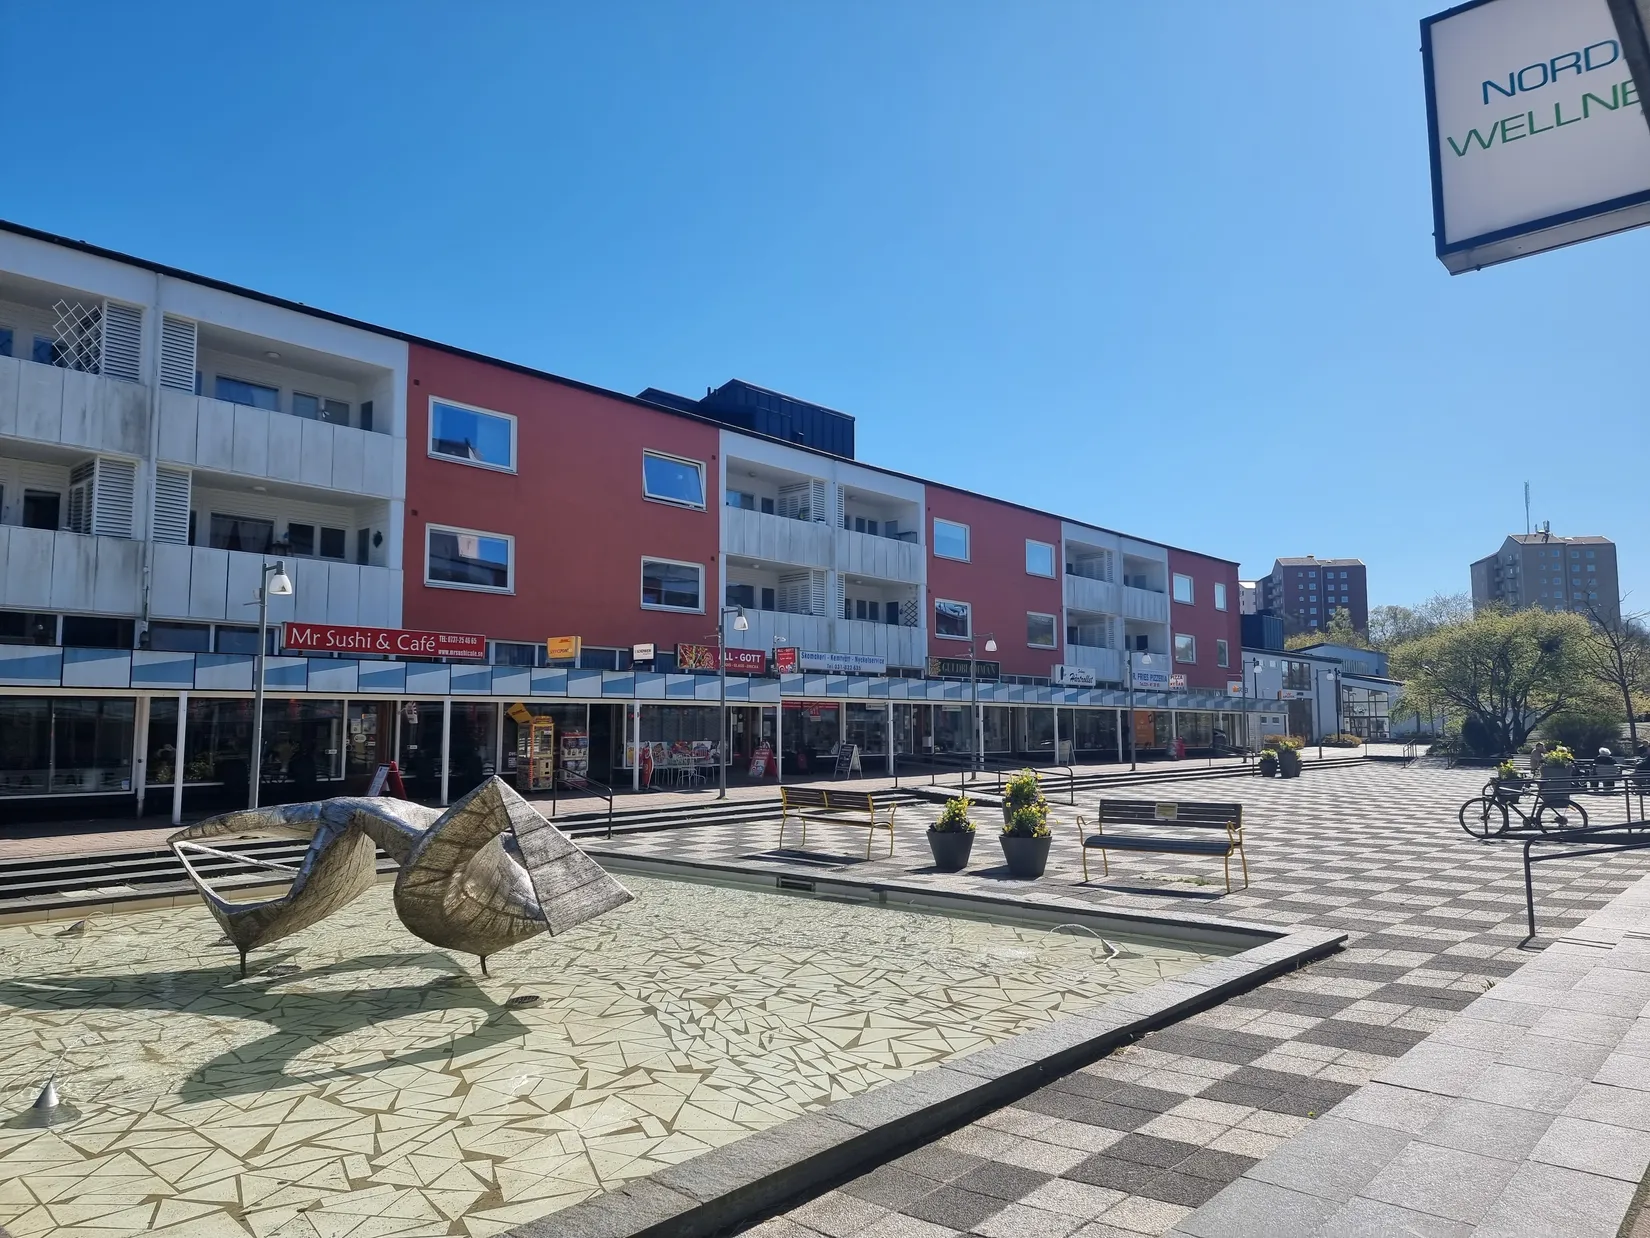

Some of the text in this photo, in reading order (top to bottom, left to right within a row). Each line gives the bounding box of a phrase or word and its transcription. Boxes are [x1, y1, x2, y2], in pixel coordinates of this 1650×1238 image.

[1482, 39, 1623, 105] NORD
[1447, 79, 1642, 157] WELLNE
[290, 628, 436, 652] Mr Sushi & Café
[739, 653, 761, 663] GOTT
